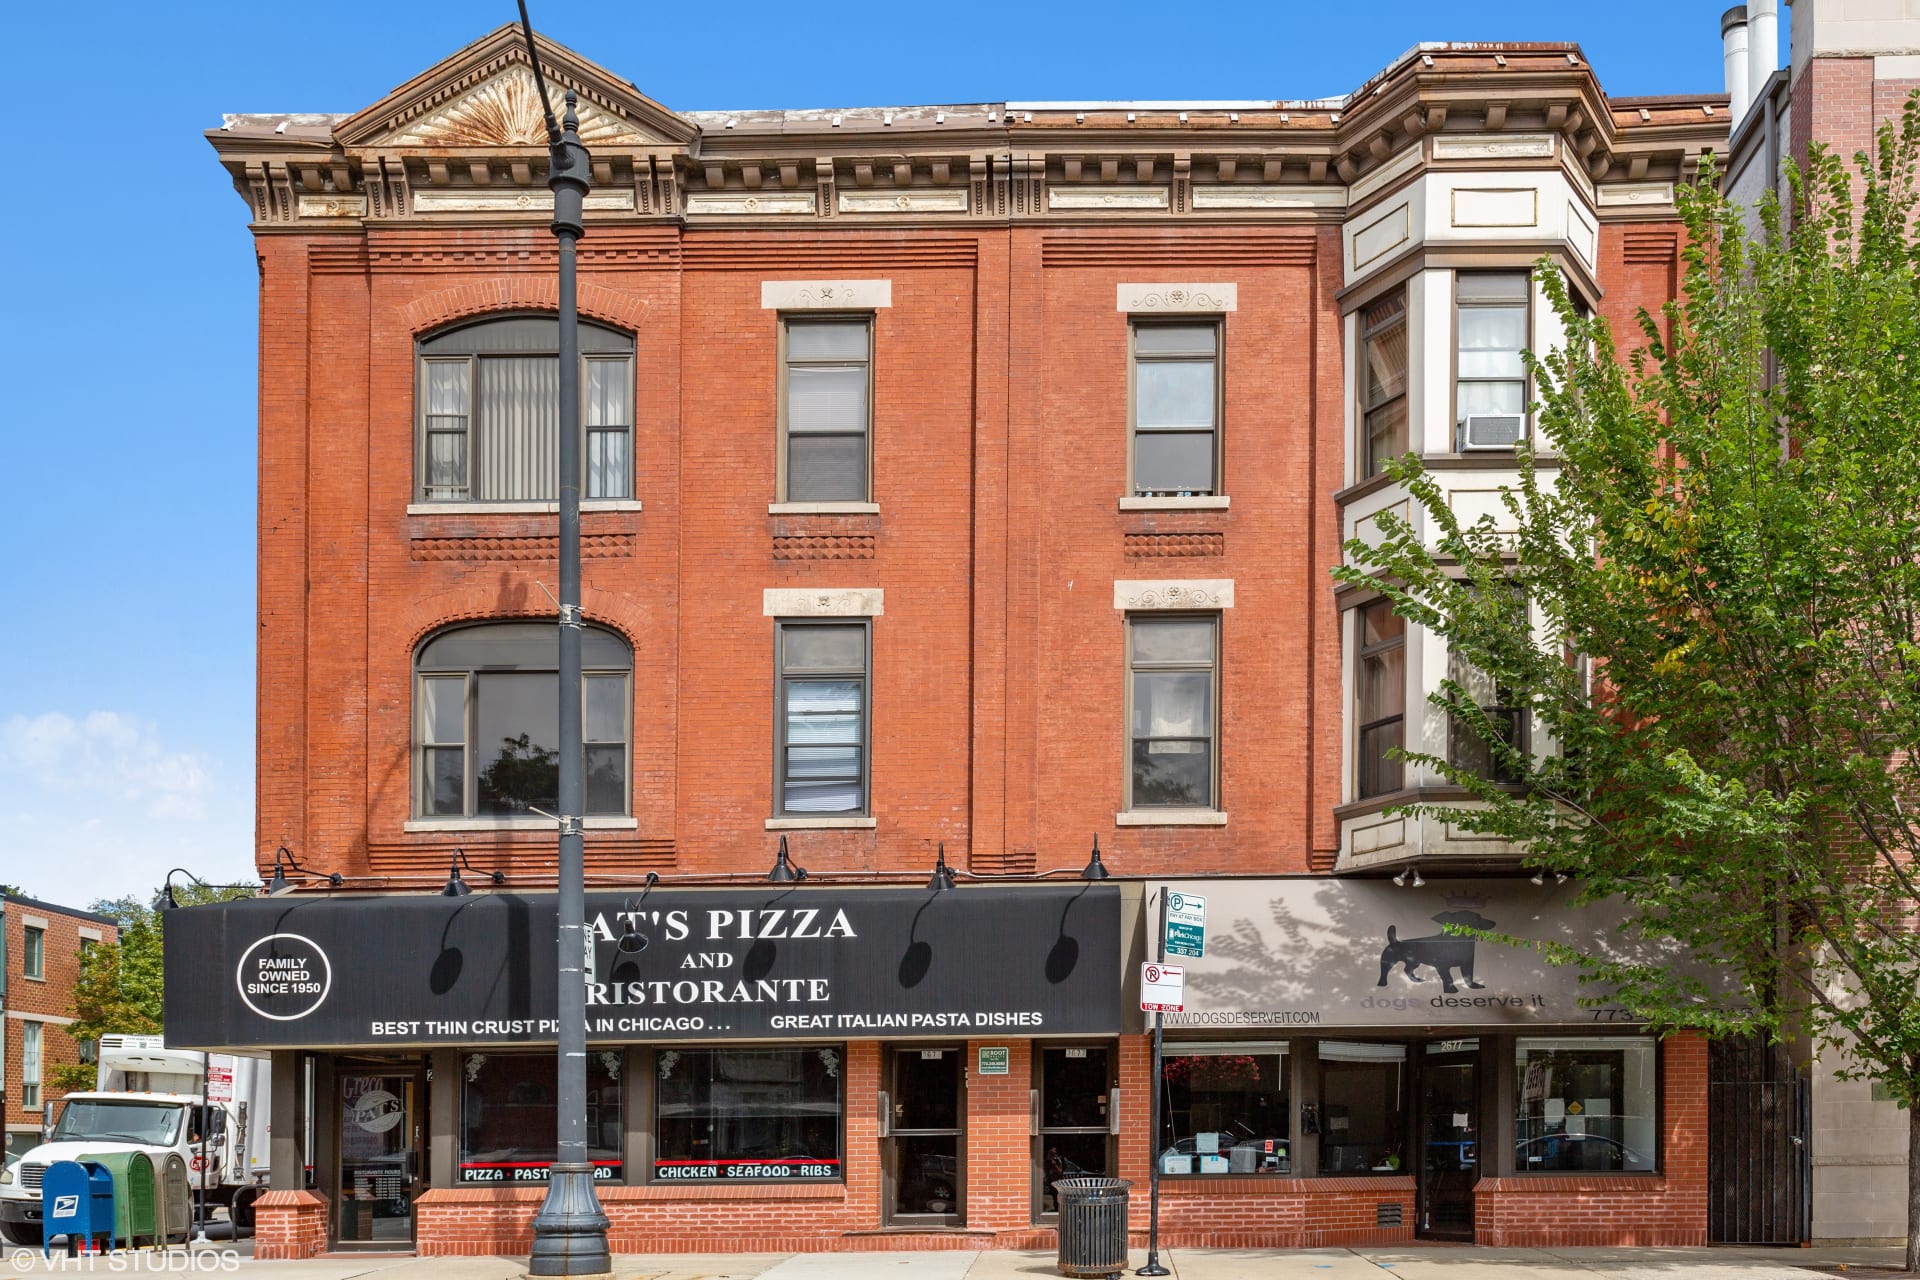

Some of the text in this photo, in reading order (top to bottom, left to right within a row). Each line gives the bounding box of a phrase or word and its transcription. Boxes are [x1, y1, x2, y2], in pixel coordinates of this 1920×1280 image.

[557, 908, 858, 942] AT'S PIZZA
[258, 958, 307, 969] FAMILY
[680, 952, 734, 969] AND
[258, 970, 310, 982] OWNED
[247, 982, 321, 994] SINCE 1950
[586, 979, 830, 1006] RISTORANTE
[1144, 1003, 1180, 1012] TOW ZONE
[1360, 994, 1546, 1011] dogs deserve it
[371, 1021, 420, 1035] BEST
[425, 1020, 467, 1035] THIN
[471, 1019, 534, 1034] CRUST
[538, 1018, 592, 1033] PIA
[596, 1018, 614, 1032] IN
[618, 1016, 704, 1032] CHICAGO
[770, 1011, 1043, 1029] GREAT ITALIAN PASTA DISHES
[1441, 1040, 1463, 1051] 2677
[465, 1168, 552, 1181] PIZZA PAST
[659, 1165, 832, 1178] CHICKEN SEAFOOD RIBS
